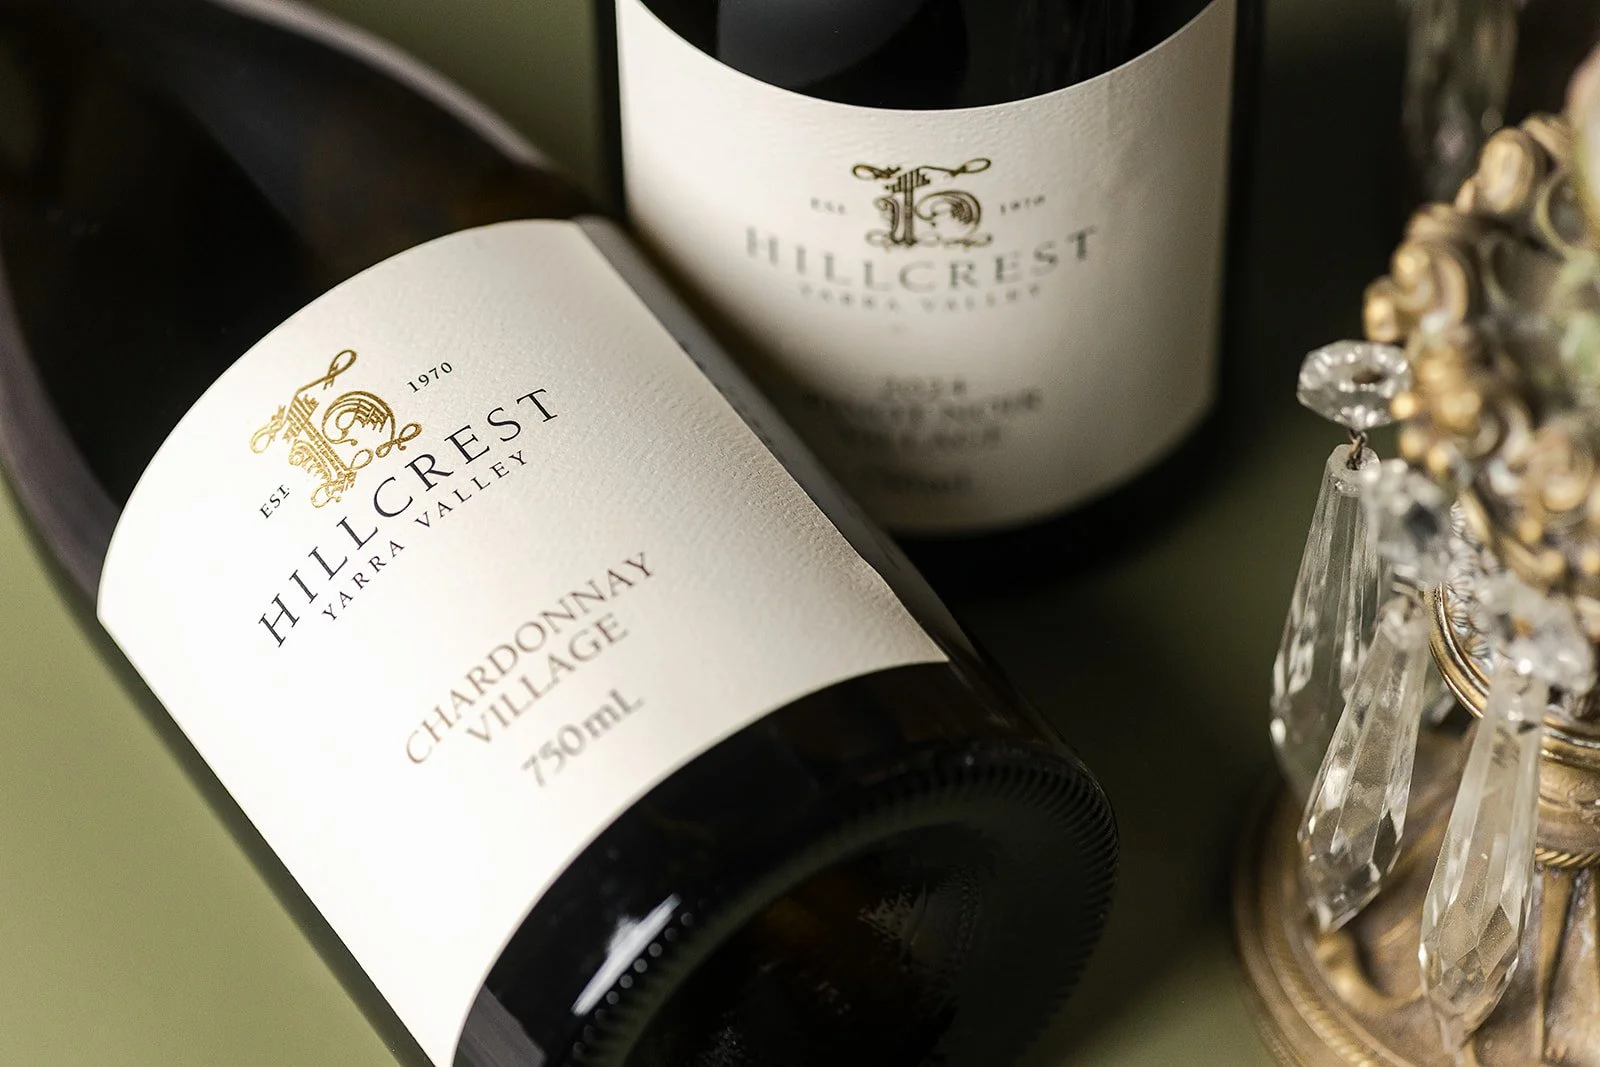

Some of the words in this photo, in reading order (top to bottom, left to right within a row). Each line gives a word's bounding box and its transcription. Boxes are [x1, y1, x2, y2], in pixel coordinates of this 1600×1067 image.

[745, 224, 1099, 293] HILLCREST
[406, 361, 454, 393] 1970
[258, 388, 558, 648] HILLCREST
[321, 540, 405, 622] YARRA
[414, 450, 529, 530] VALLEY
[405, 551, 654, 765] CHARDONNAY
[465, 612, 629, 743] VILLAGE
[520, 688, 645, 787] 750mL
